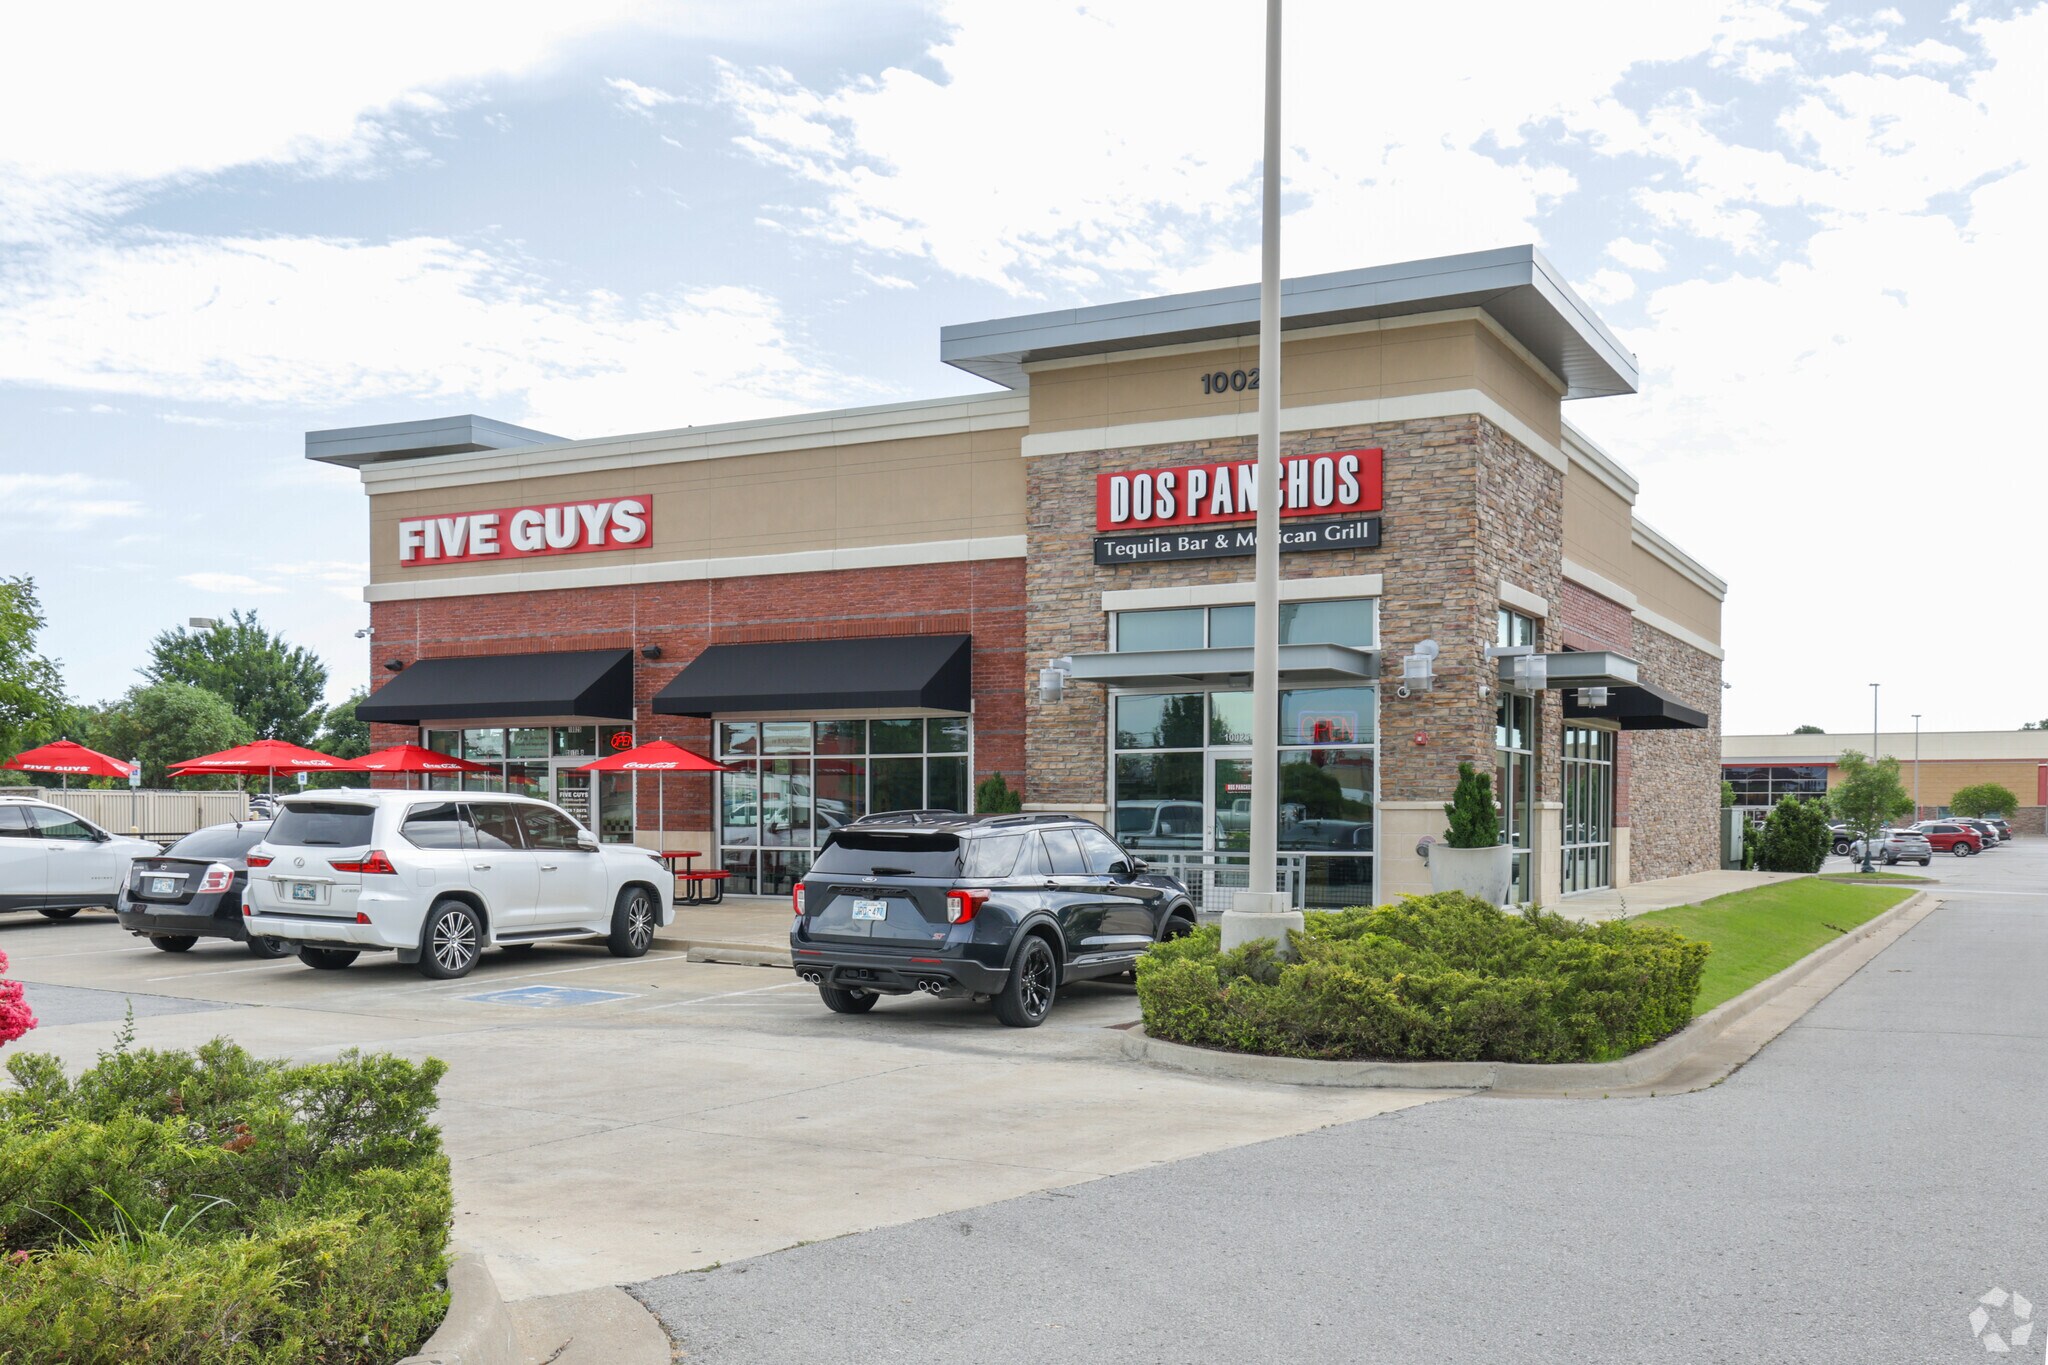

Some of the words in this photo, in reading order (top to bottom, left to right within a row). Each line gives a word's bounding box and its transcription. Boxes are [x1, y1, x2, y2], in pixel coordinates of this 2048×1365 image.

[1110, 472, 1176, 523] DOS
[1187, 455, 1360, 517] PANHOS
[399, 513, 500, 561] FIVE
[509, 500, 646, 551] GUYS
[1104, 537, 1171, 558] Tequila
[1178, 536, 1208, 552] Bar
[1214, 534, 1230, 549] &
[1236, 529, 1317, 548] Mican
[1324, 521, 1369, 540] Grill
[612, 734, 633, 747] OPEN
[1301, 715, 1355, 741] OPEN
[622, 761, 680, 769] Coca-Cola
